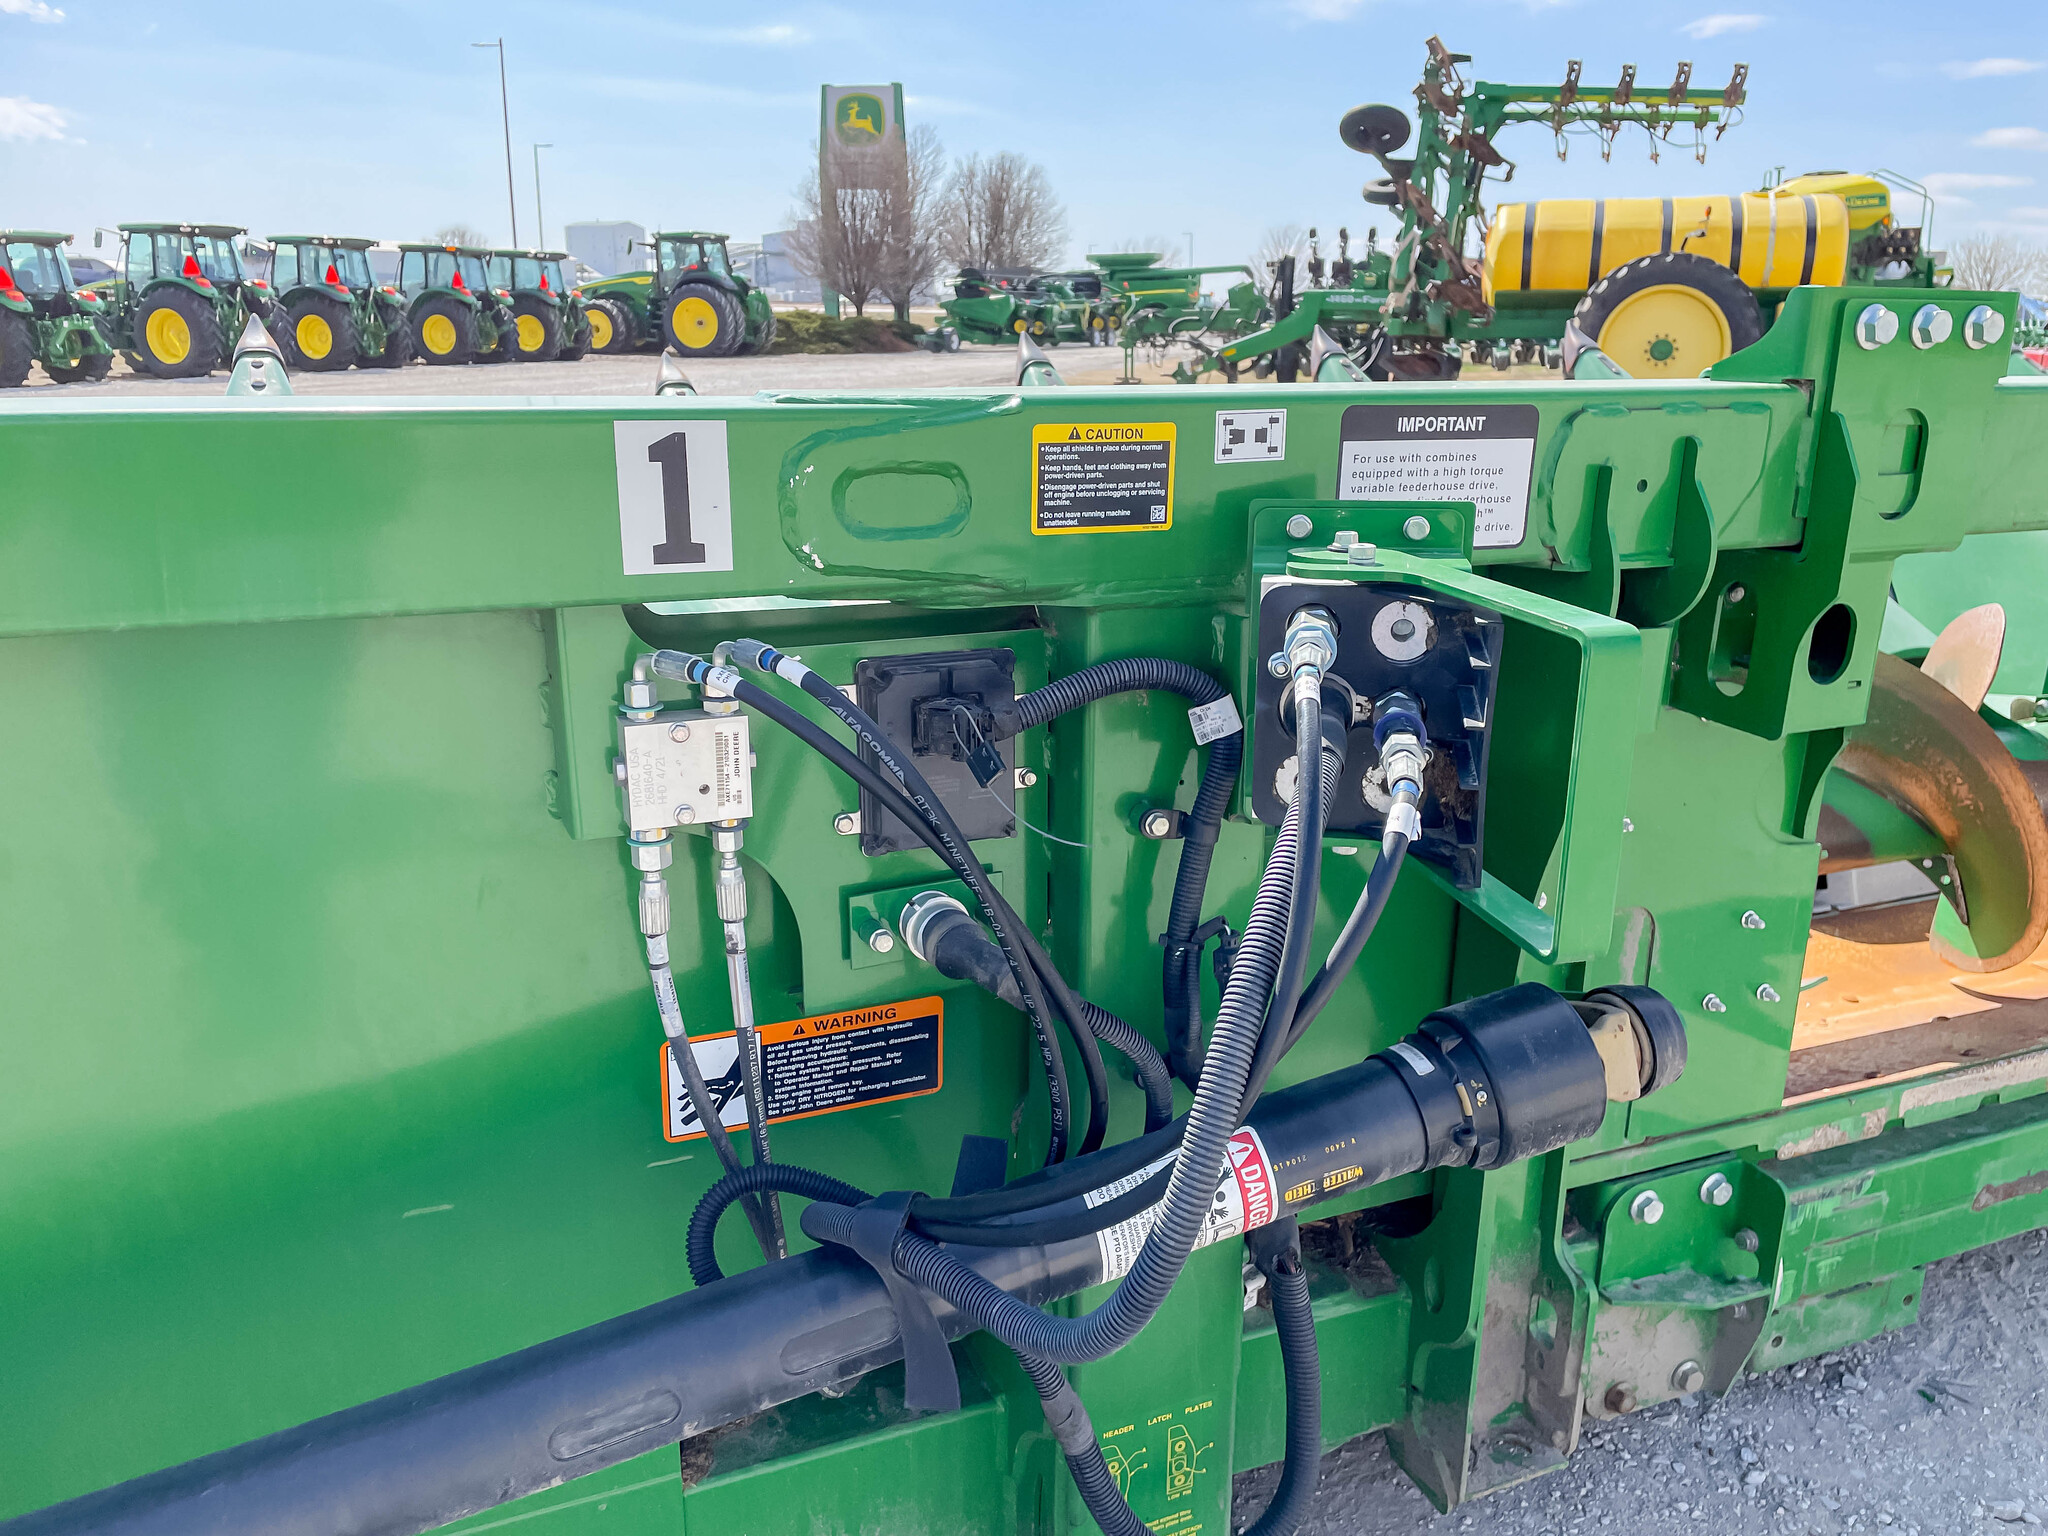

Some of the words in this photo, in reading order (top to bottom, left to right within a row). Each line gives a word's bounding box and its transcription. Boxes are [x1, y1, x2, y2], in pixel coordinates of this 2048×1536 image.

[1086, 428, 1143, 440] CAUTION
[1398, 416, 1486, 432] IMPORTANT
[1102, 444, 1120, 452] place
[1120, 444, 1140, 452] during
[1354, 454, 1372, 464] For
[1376, 455, 1395, 464] use
[1399, 454, 1422, 463] with
[1426, 452, 1477, 463] combines
[1044, 464, 1061, 473] Keep
[1062, 464, 1084, 472] hands,
[1110, 463, 1134, 472] clothing
[1352, 468, 1403, 480] equipped
[1406, 467, 1430, 478] with
[1442, 466, 1466, 479] high
[1470, 466, 1504, 478] torque
[1044, 484, 1077, 492] Disengage
[1078, 482, 1118, 491] power-driven
[1054, 492, 1075, 500] engine
[1096, 490, 1130, 498] unclogging
[1138, 488, 1166, 497] servicing
[1350, 482, 1395, 494] variable
[1398, 482, 1465, 492] feederhouse
[1468, 480, 1498, 491] drive,
[647, 432, 707, 567] 1
[1044, 518, 1079, 526] unattended.
[1081, 510, 1105, 518] running
[1484, 523, 1514, 532] drive.
[830, 706, 906, 786] ALFAGOMMA
[630, 747, 640, 768] USA
[655, 756, 666, 779] 4/21
[642, 750, 656, 806] 2681640-A
[631, 773, 643, 808] HYDAC
[914, 795, 942, 827] AT3K
[940, 832, 1005, 938] MINETUFF-1B-04
[1002, 946, 1022, 972] 1/4"
[1024, 994, 1036, 1010] WP
[814, 1008, 897, 1032] WARNING
[767, 1044, 784, 1052] Avoid
[787, 1040, 810, 1048] serious
[848, 1030, 870, 1038] contact
[886, 1022, 913, 1031] hydraulic
[826, 1040, 853, 1050] pressure.
[748, 1044, 756, 1060] R17
[767, 1058, 788, 1066] Before
[790, 1053, 818, 1062] removing
[820, 1048, 848, 1058] hydraulic
[850, 1041, 887, 1052] components,
[888, 1033, 930, 1044] disassembling
[1041, 1046, 1053, 1067] MPa
[774, 1072, 796, 1080] Relieve
[798, 1066, 820, 1075] system
[822, 1061, 850, 1070] hydraulic
[852, 1056, 882, 1065] pressures.
[776, 1062, 804, 1072] changing
[807, 1055, 848, 1066] accumulators:
[784, 1076, 810, 1084] Operator
[812, 1071, 834, 1079] Manual
[850, 1064, 868, 1072] Repair
[871, 1060, 892, 1068] Manual
[750, 1061, 760, 1087] 11237
[754, 1087, 762, 1102] ISO
[774, 1085, 796, 1094] system
[798, 1078, 834, 1088] information.
[774, 1093, 790, 1101] Stop
[792, 1090, 812, 1098] engine
[828, 1082, 850, 1090] remove
[814, 1090, 846, 1100] NITROGEN
[859, 1082, 890, 1092] recharging
[892, 1075, 928, 1086] accumulator.
[1048, 1074, 1061, 1104] (3300
[836, 1095, 854, 1103] dealer.
[1053, 1108, 1062, 1132] PSI)
[1324, 1141, 1346, 1154] 2400
[1240, 1164, 1269, 1228] DANGE
[1113, 1237, 1122, 1253] PTO
[1132, 1221, 1143, 1249] GUARDS
[1103, 1424, 1134, 1439] HEADER
[1147, 1413, 1172, 1426] LATCH
[1184, 1400, 1213, 1414] PLATES
